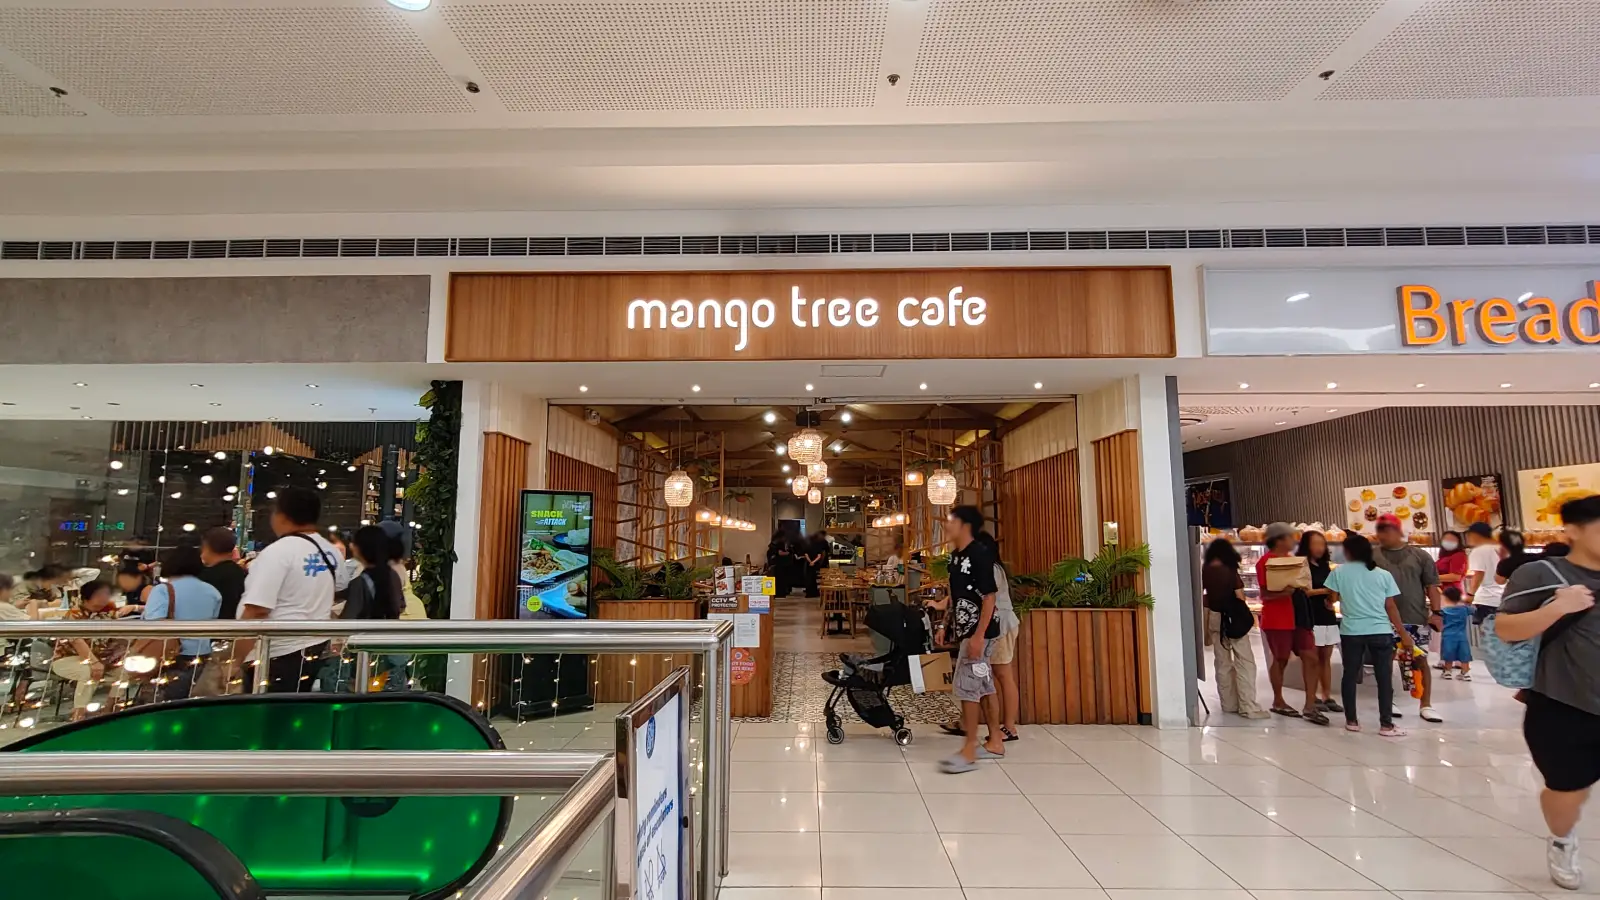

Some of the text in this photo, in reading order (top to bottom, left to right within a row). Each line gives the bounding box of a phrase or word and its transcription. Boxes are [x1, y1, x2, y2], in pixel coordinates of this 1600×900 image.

[627, 285, 987, 351] mango tree cafe
[1396, 280, 1600, 346] Bread
[530, 510, 564, 518] SNACK
[543, 518, 567, 526] ATTACK
